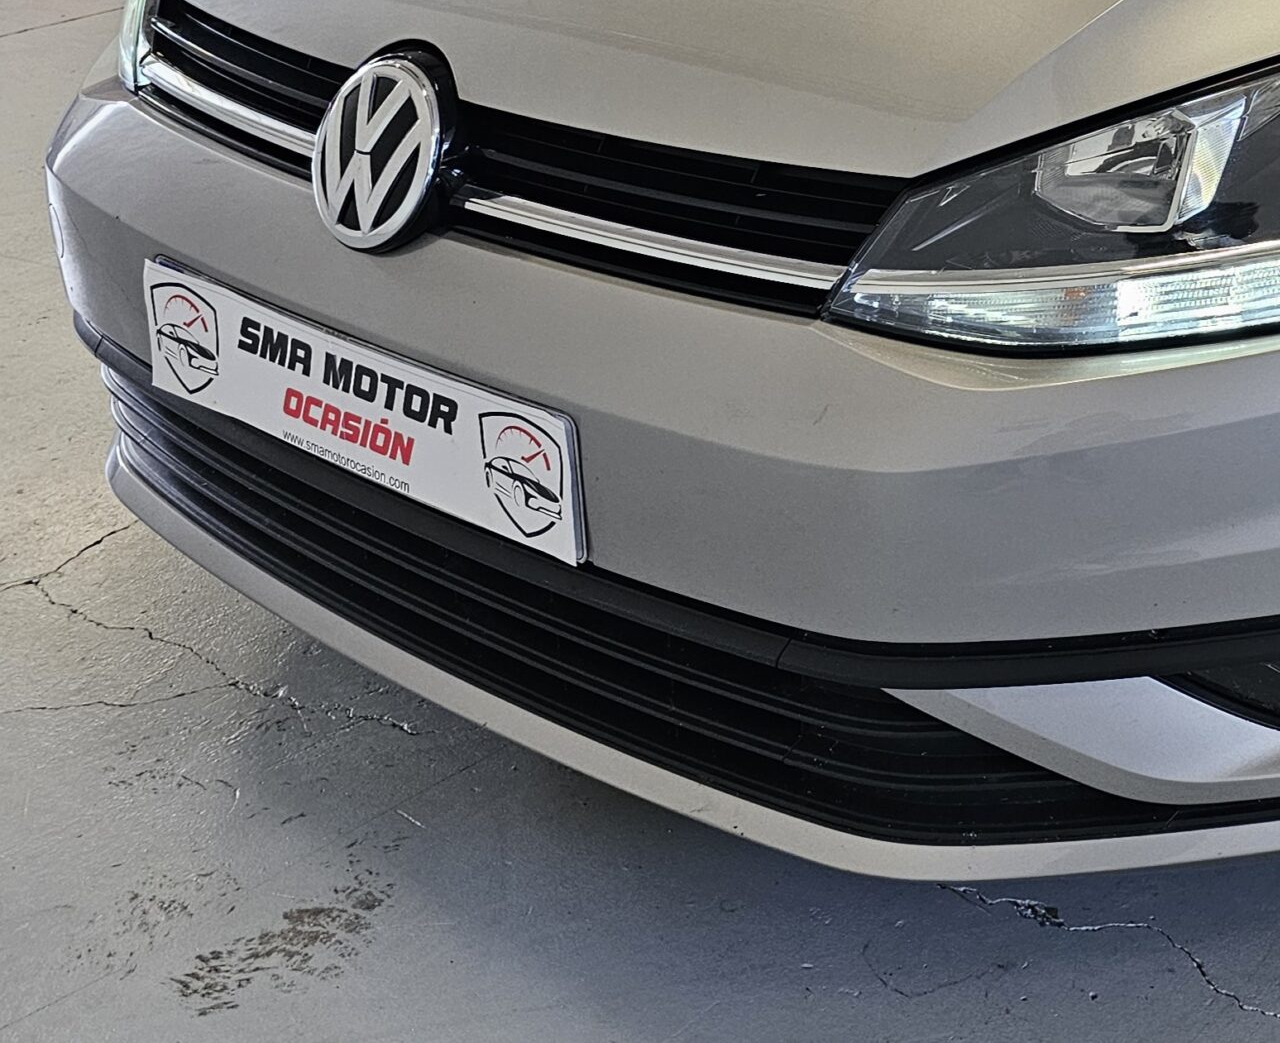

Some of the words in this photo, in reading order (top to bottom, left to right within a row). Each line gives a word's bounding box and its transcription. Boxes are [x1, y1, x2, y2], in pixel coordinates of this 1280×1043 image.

[238, 316, 312, 377] SMA
[323, 352, 458, 435] MOTOR
[282, 429, 410, 494] www.smamotorocasion.com
[283, 387, 415, 466] OCASIÓN
